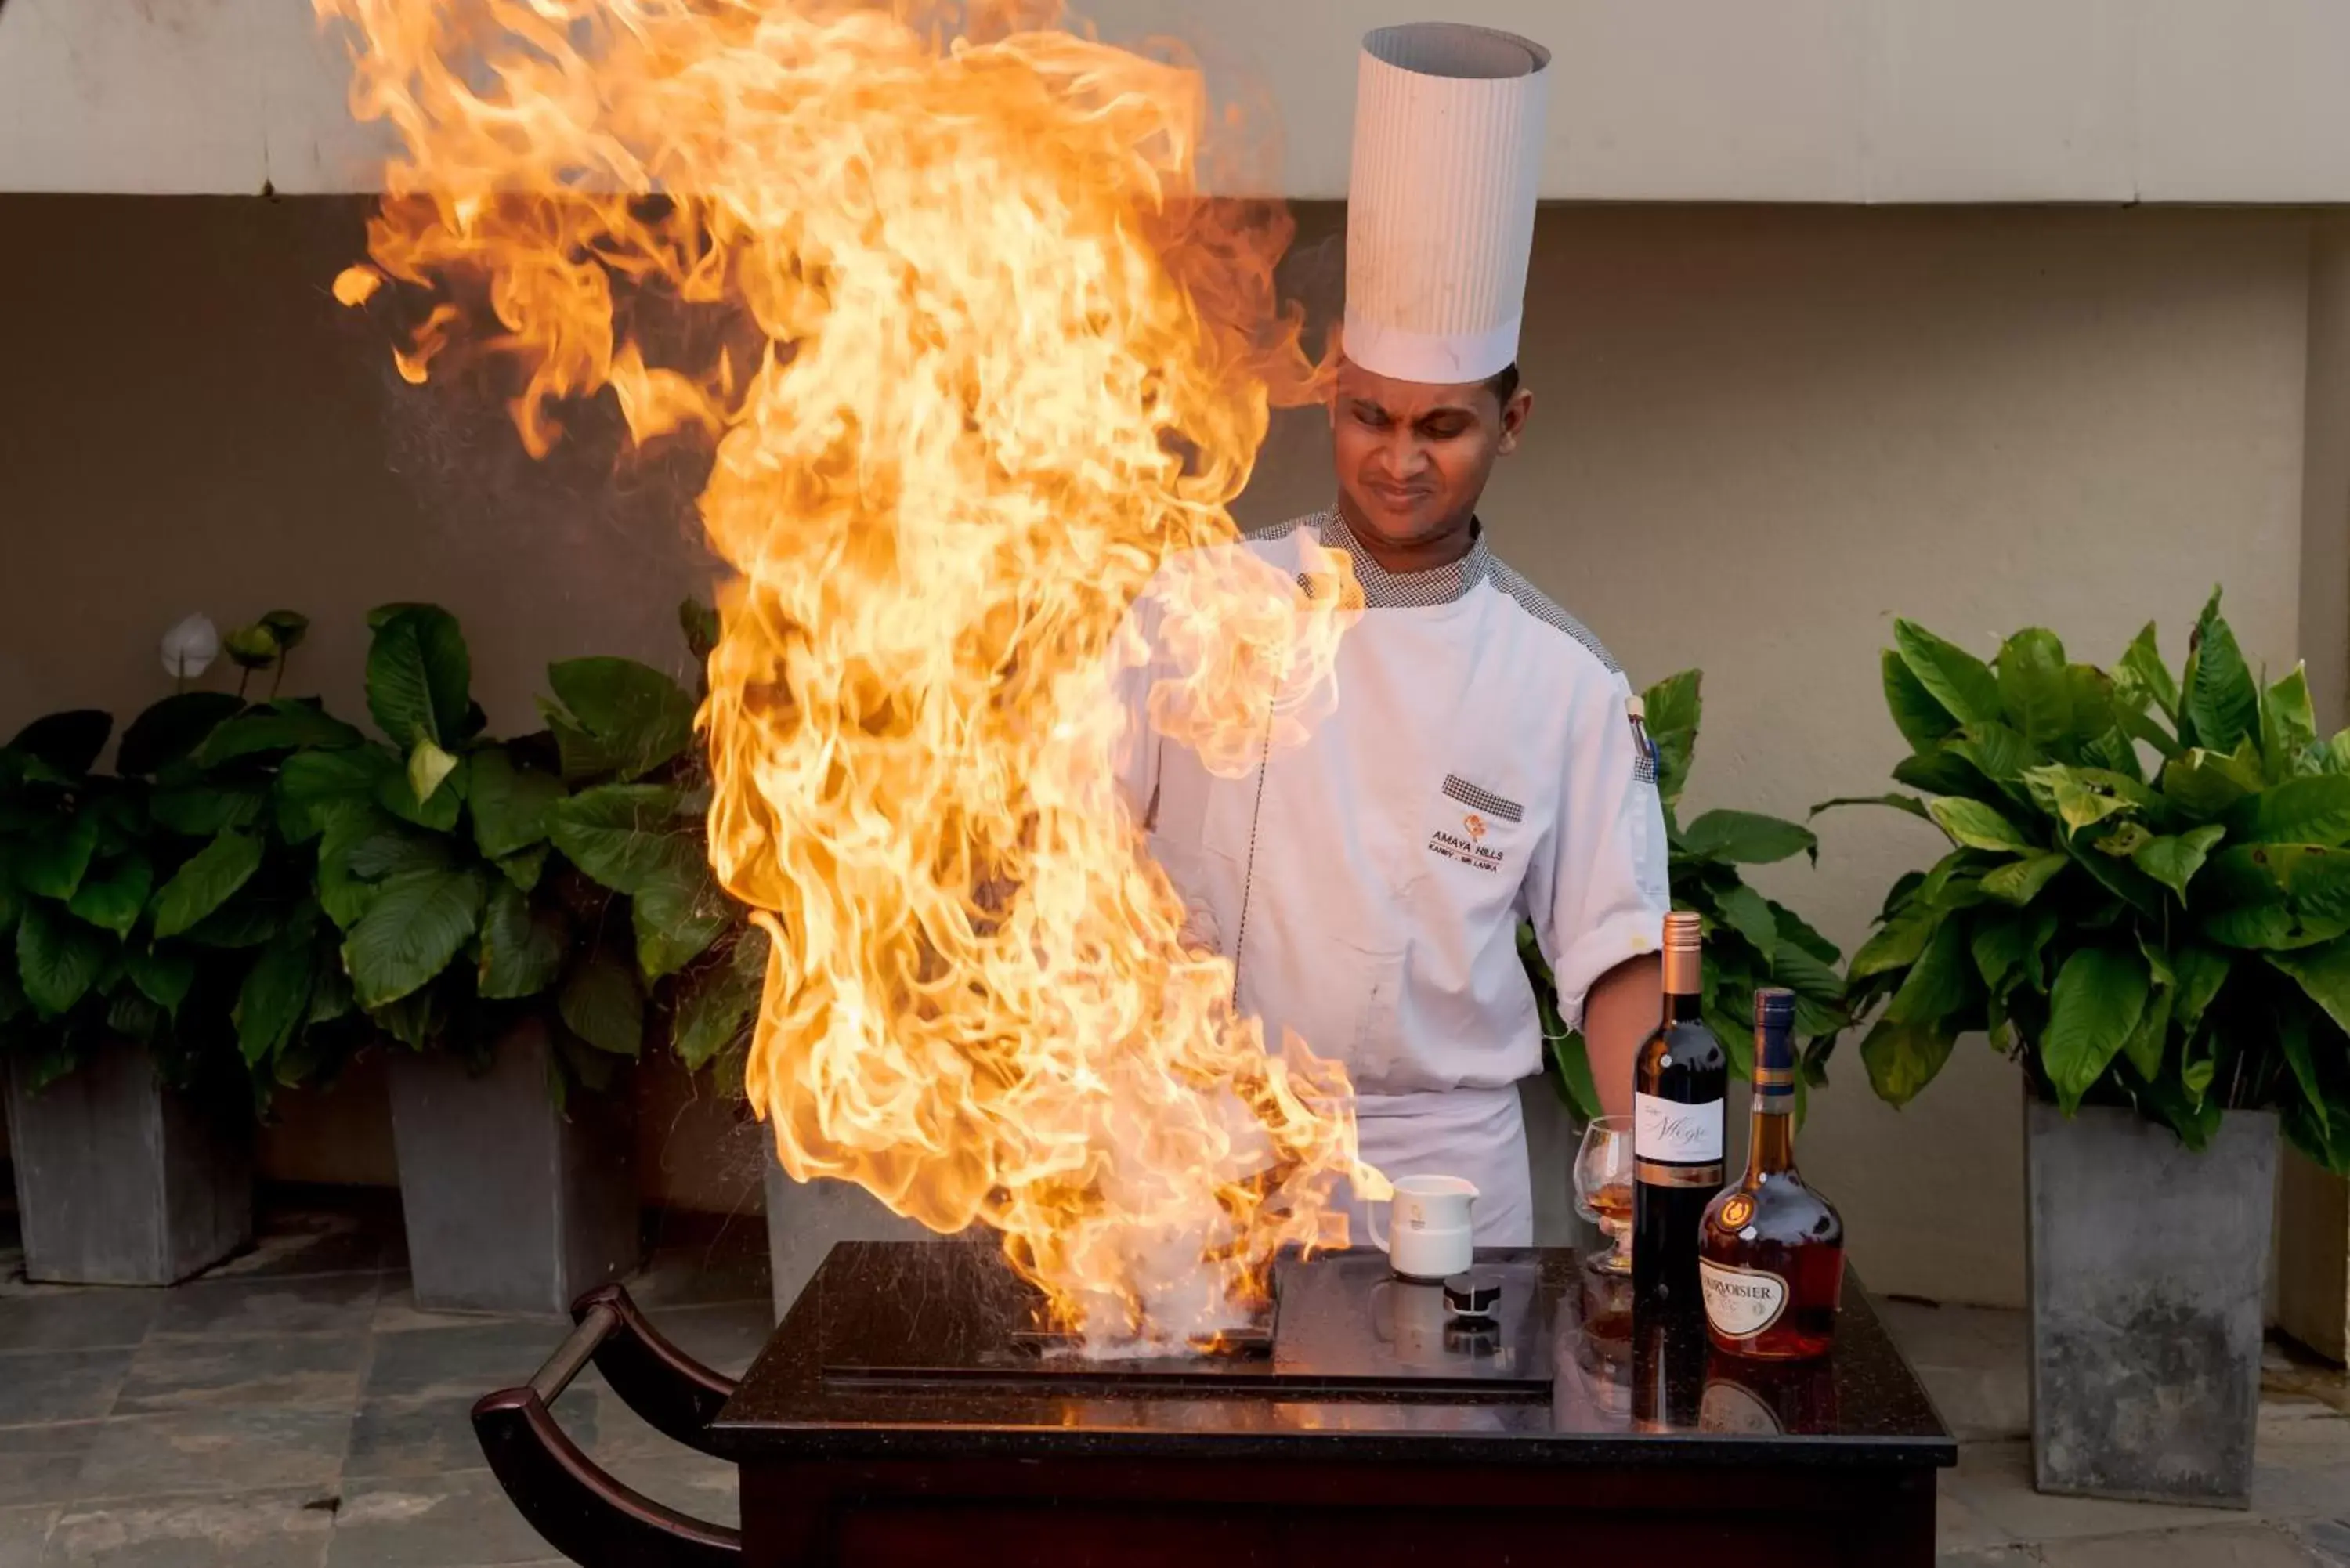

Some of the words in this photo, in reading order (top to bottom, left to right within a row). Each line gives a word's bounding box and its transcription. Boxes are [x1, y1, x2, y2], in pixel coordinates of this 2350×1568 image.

[1432, 830, 1471, 853] AMAYA
[1475, 846, 1504, 861] HILLS
[1473, 861, 1498, 874] LANKA
